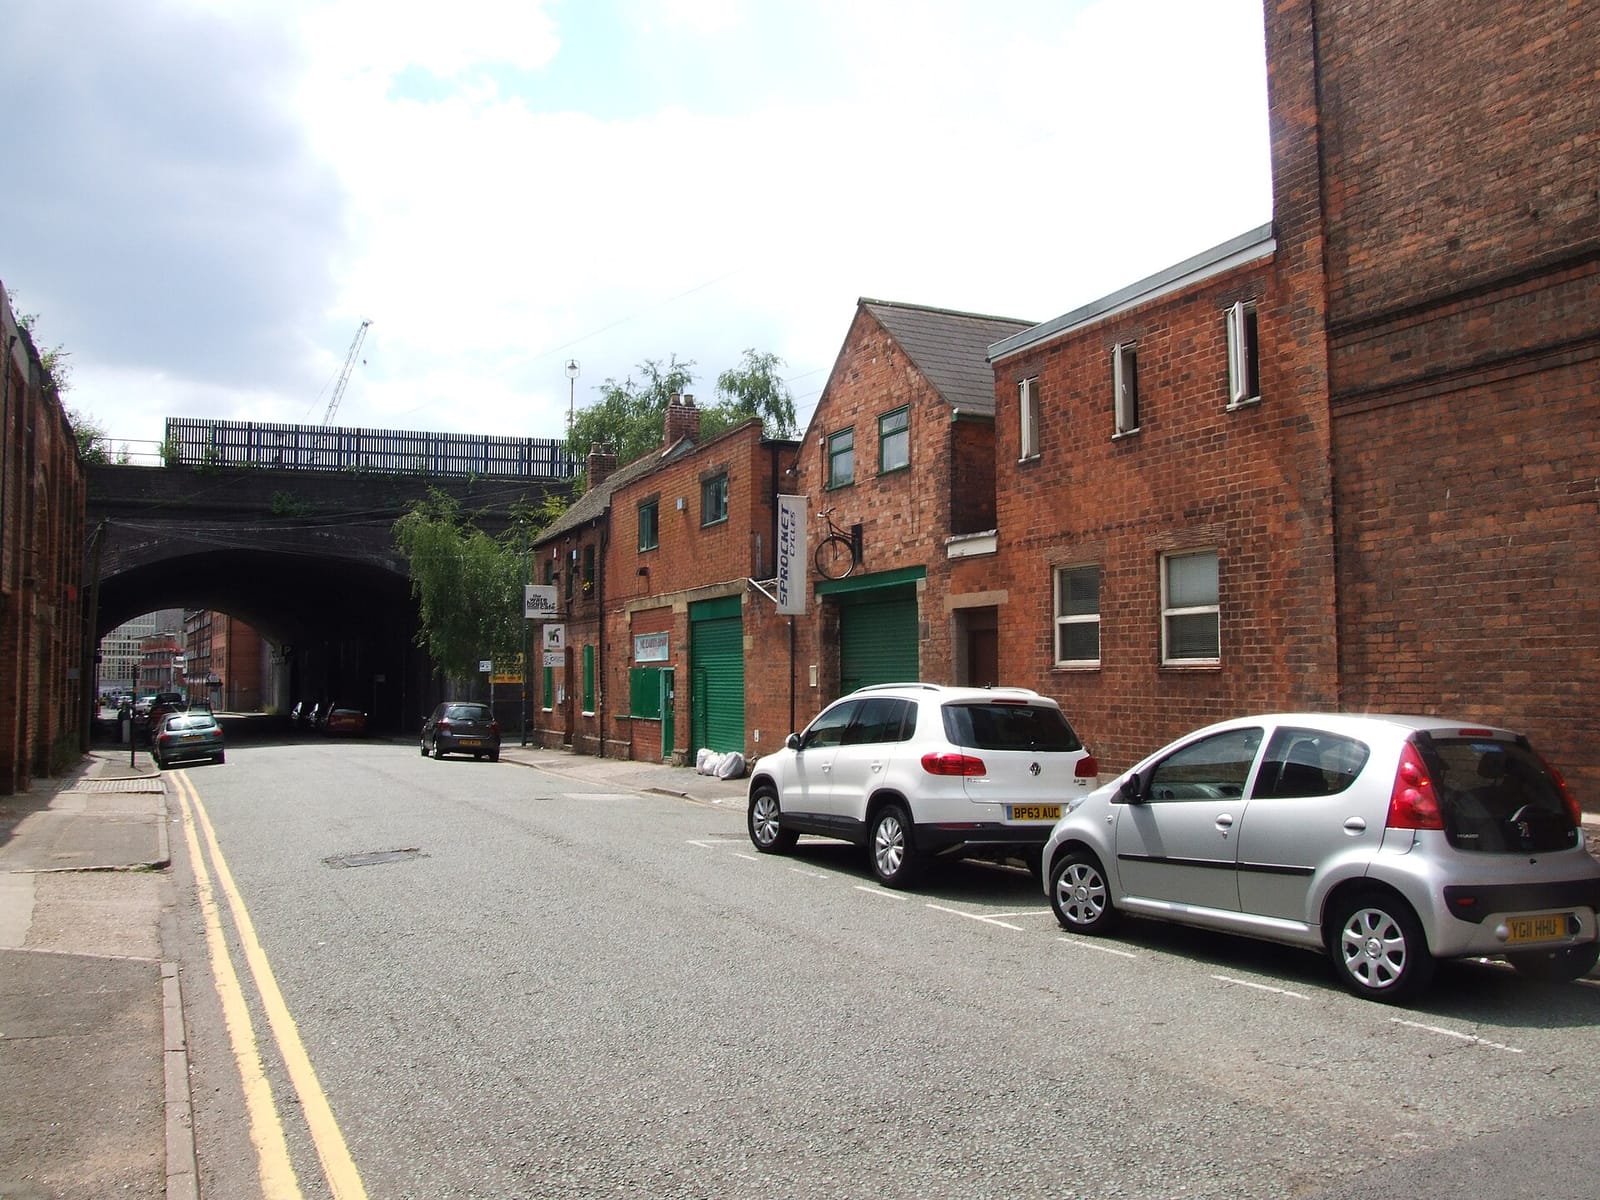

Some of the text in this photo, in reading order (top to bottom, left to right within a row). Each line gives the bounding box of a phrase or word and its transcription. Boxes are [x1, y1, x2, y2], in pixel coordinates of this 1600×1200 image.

[780, 504, 789, 606] SPROCKET
[1014, 808, 1060, 819] BP63 AUC
[1511, 919, 1557, 938] YG11 HHU
